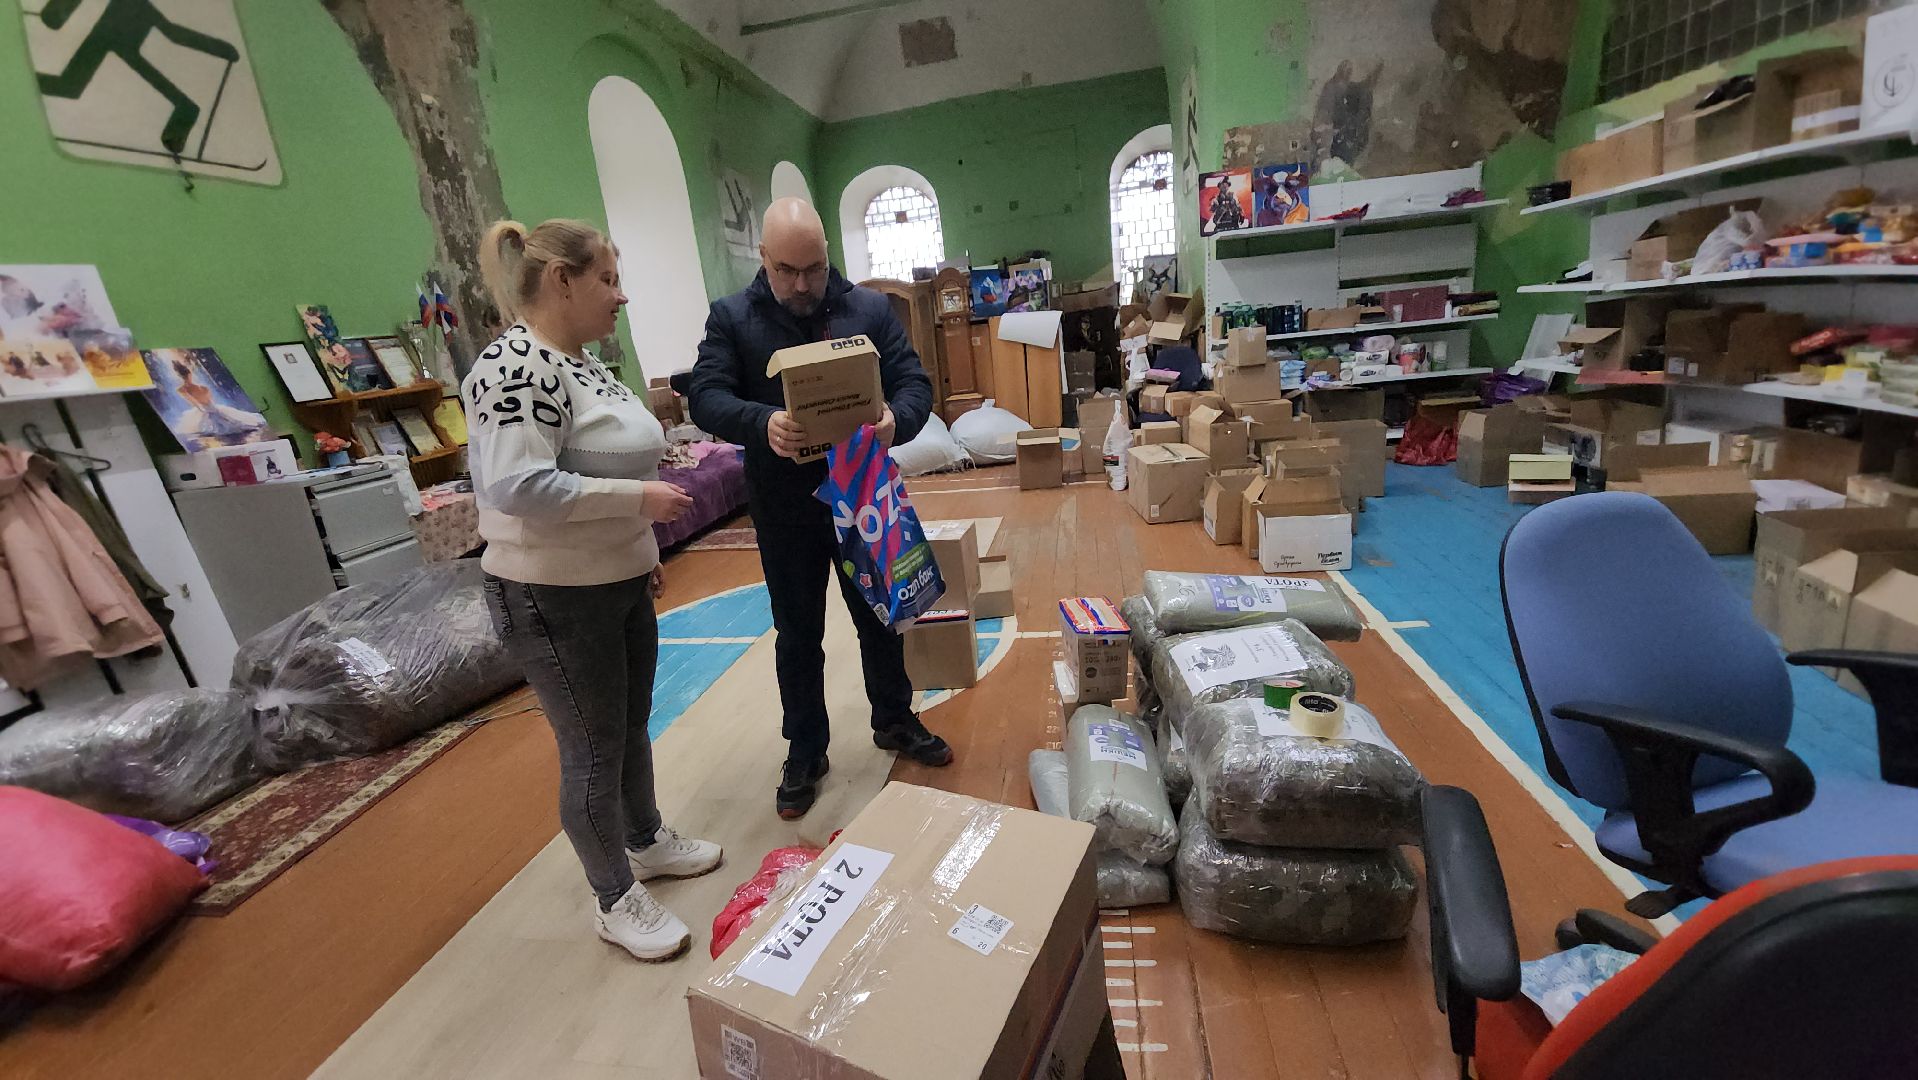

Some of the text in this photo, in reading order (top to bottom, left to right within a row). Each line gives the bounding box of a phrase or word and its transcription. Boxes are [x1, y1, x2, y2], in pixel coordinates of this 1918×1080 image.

[760, 857, 864, 962] 2 РОТА
[977, 942, 988, 950] 20
